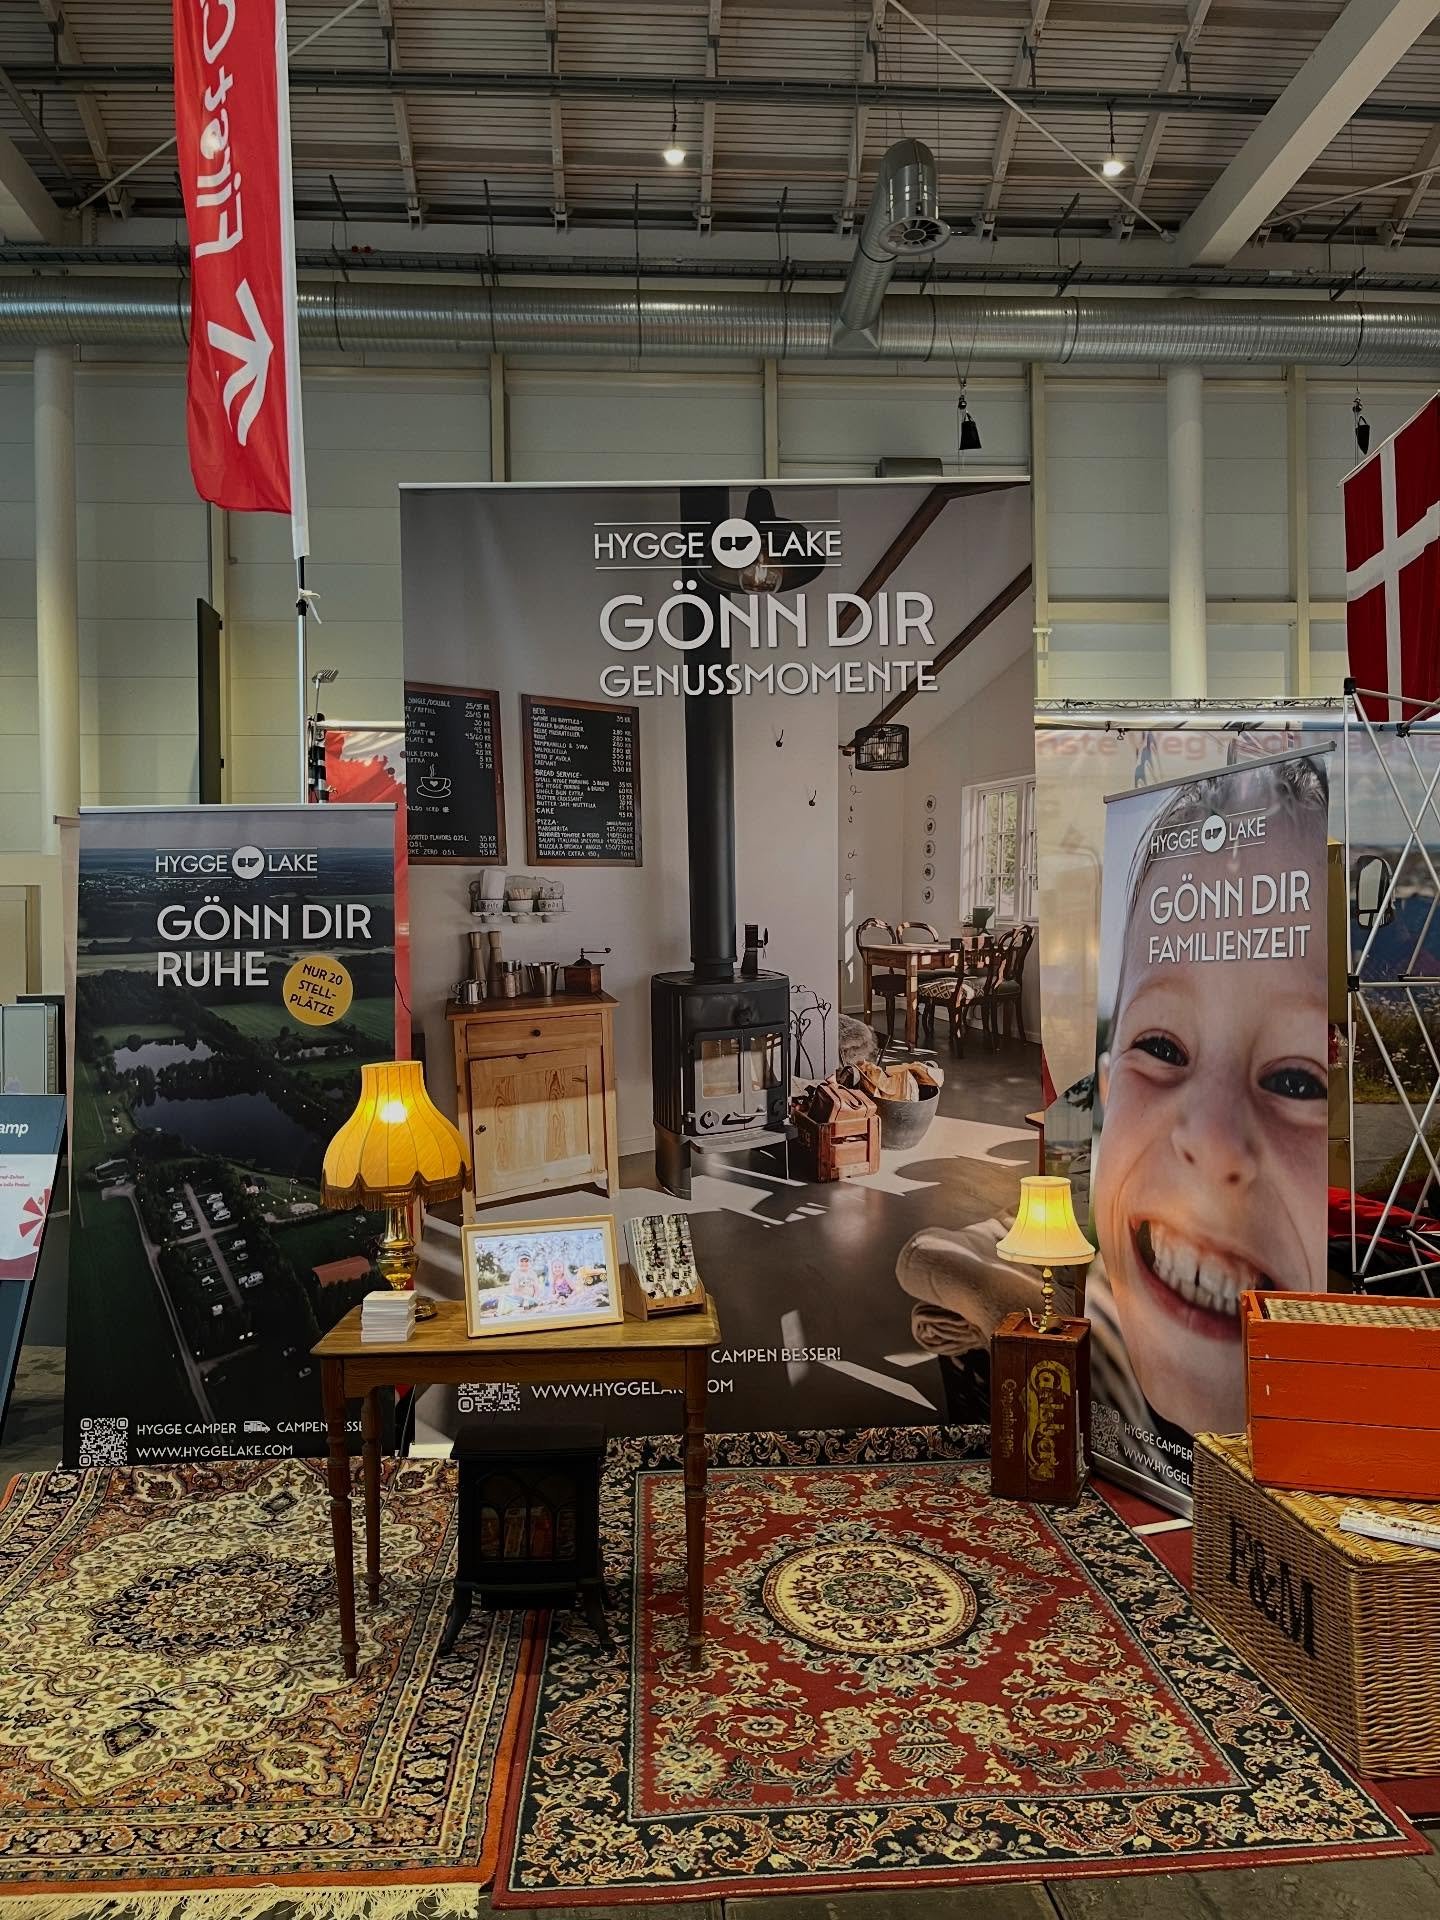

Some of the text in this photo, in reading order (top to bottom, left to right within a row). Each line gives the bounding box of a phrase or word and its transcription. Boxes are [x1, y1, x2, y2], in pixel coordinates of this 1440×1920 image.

[594, 529, 843, 559] HYGGE LAKE
[599, 578, 936, 651] GÖNN DIR
[599, 657, 939, 699] GENUSSMOMENTE
[1150, 816, 1267, 855] HYGGE LAKE
[155, 854, 318, 873] HYGGE LAKE
[1150, 869, 1312, 925] GÖNN DIR
[156, 895, 373, 941] GÖNN DIR
[1148, 924, 1312, 964] FAMILIENZEIT
[157, 951, 270, 988] RUHE
[302, 963, 344, 986] NUR 20
[289, 993, 335, 1017] PLÄTZE
[298, 980, 337, 1000] STELL-
[711, 1347, 842, 1364] CAMPEN BESSER!
[531, 1379, 734, 1399] WWW.HYGGELOM
[136, 1421, 329, 1436] HYGGE CAMPER CAMPEN
[1124, 1422, 1193, 1463] HYGGE CAMPER
[136, 1444, 294, 1458] WWW.HYGGELAKE.COM
[1123, 1446, 1193, 1488] WWW.HYGGEL
